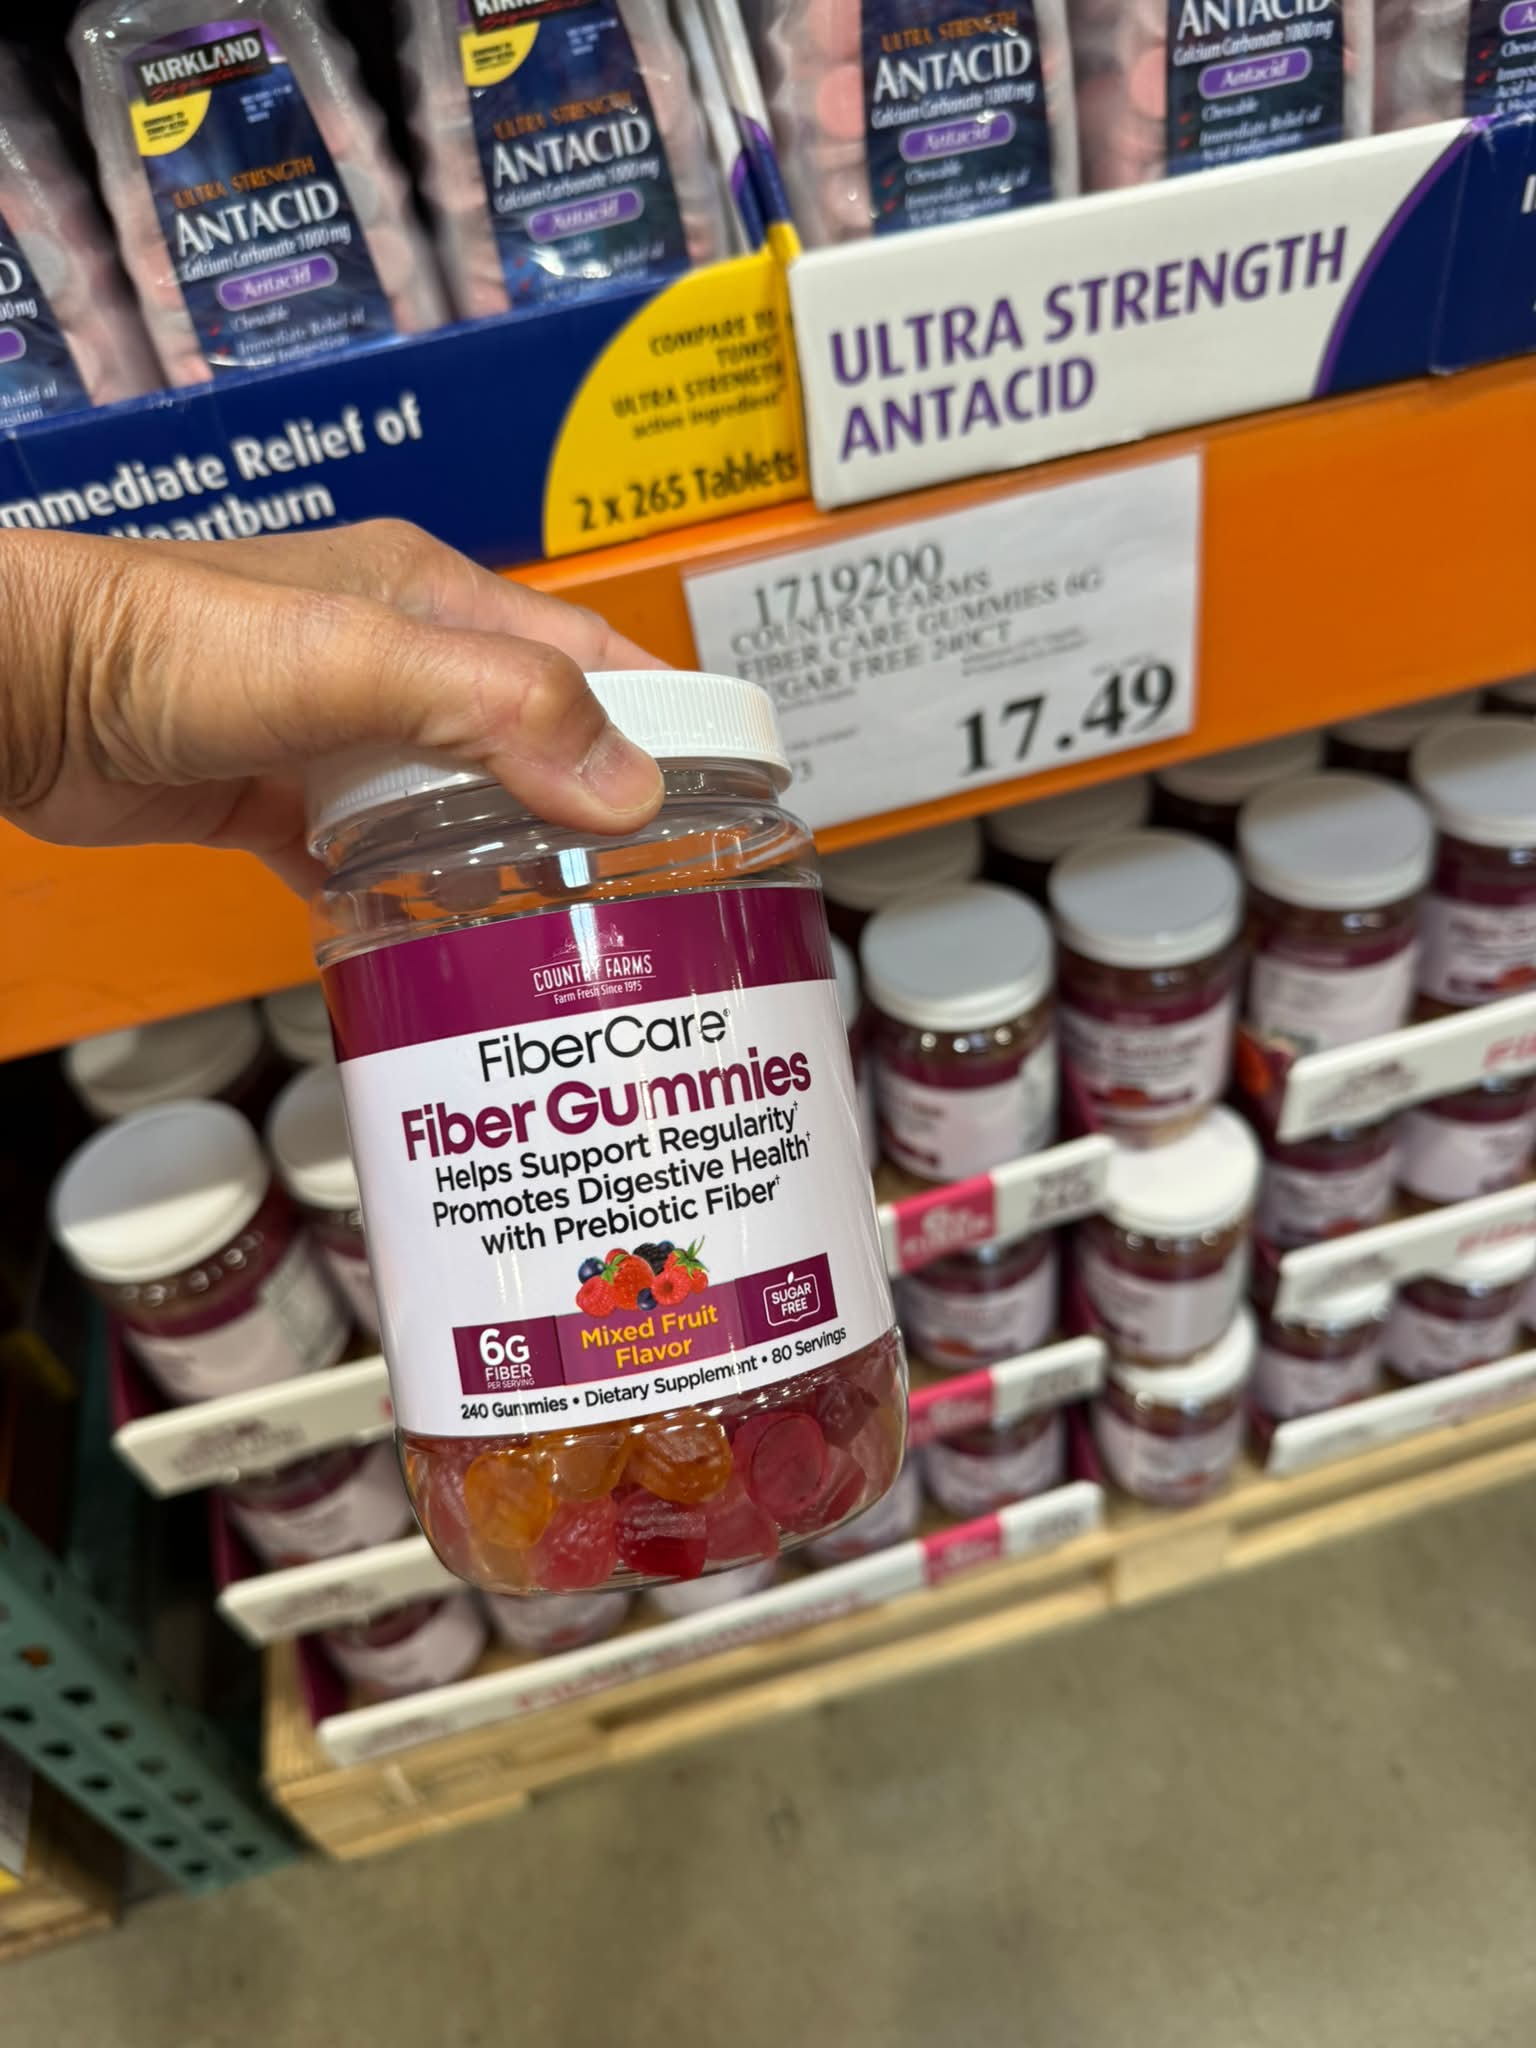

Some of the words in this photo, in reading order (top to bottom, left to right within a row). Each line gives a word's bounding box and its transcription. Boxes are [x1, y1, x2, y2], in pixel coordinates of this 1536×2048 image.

[141, 37, 262, 86] KIRKLAND
[873, 37, 1032, 103] ANTACID
[1219, 57, 1289, 88] Antacid
[492, 117, 651, 188] ANTACID
[173, 181, 228, 209] ULTRA
[230, 157, 316, 193] STRENGTH
[176, 181, 339, 257] ANTACID
[181, 256, 233, 282] Calcium
[233, 240, 297, 267] Carbonate
[242, 263, 311, 298] Antacid
[829, 296, 1025, 387] ULTRA
[1044, 226, 1349, 344] STRENGTH
[612, 386, 680, 419] ULTRA
[838, 357, 1097, 463] ANTACID
[0, 454, 229, 529] mmediate
[230, 405, 367, 481] Relief
[374, 393, 423, 446] of
[573, 494, 595, 533] 2
[602, 498, 624, 527] x
[626, 473, 687, 520] 265
[692, 451, 799, 502] Tablets
[730, 603, 875, 656] COUNTRY
[887, 569, 991, 617] FARMS
[754, 541, 946, 629] 1719200
[735, 642, 819, 682] FIBER
[828, 619, 909, 661] CARE
[916, 580, 1058, 636] GUMMIES
[758, 665, 841, 702] UGAR
[849, 648, 921, 682] FREE
[958, 662, 1177, 778] 17.49
[533, 959, 600, 992] COUNTRY
[605, 954, 653, 978] FARMS
[553, 990, 576, 1005] Farm
[576, 985, 600, 1000] Fresh
[601, 983, 623, 996] Since
[400, 1100, 536, 1162] Fiber
[546, 1046, 812, 1136] Gummies
[433, 1184, 570, 1228] Promotes
[577, 1154, 724, 1207] Digestive
[435, 1159, 513, 1193] Helps
[522, 1133, 651, 1178] Support
[481, 1225, 547, 1256] with
[554, 1197, 699, 1246] Prebiotic
[771, 1281, 813, 1306] SUGAR
[780, 1298, 809, 1317] FREE
[479, 1327, 530, 1367] 6G
[580, 1320, 656, 1350] Mixed
[660, 1303, 719, 1338] Fruit
[614, 1337, 693, 1370] Flavor
[460, 1403, 490, 1422] 240
[492, 1395, 569, 1418] Gummies
[583, 1381, 650, 1408] Dietary
[653, 1357, 759, 1399] Supplement
[770, 1345, 794, 1365] 80
[795, 1325, 848, 1358] Servings
[485, 1363, 533, 1382] FIBER
[487, 1380, 502, 1390] PER
[502, 1377, 536, 1389] SERVING
